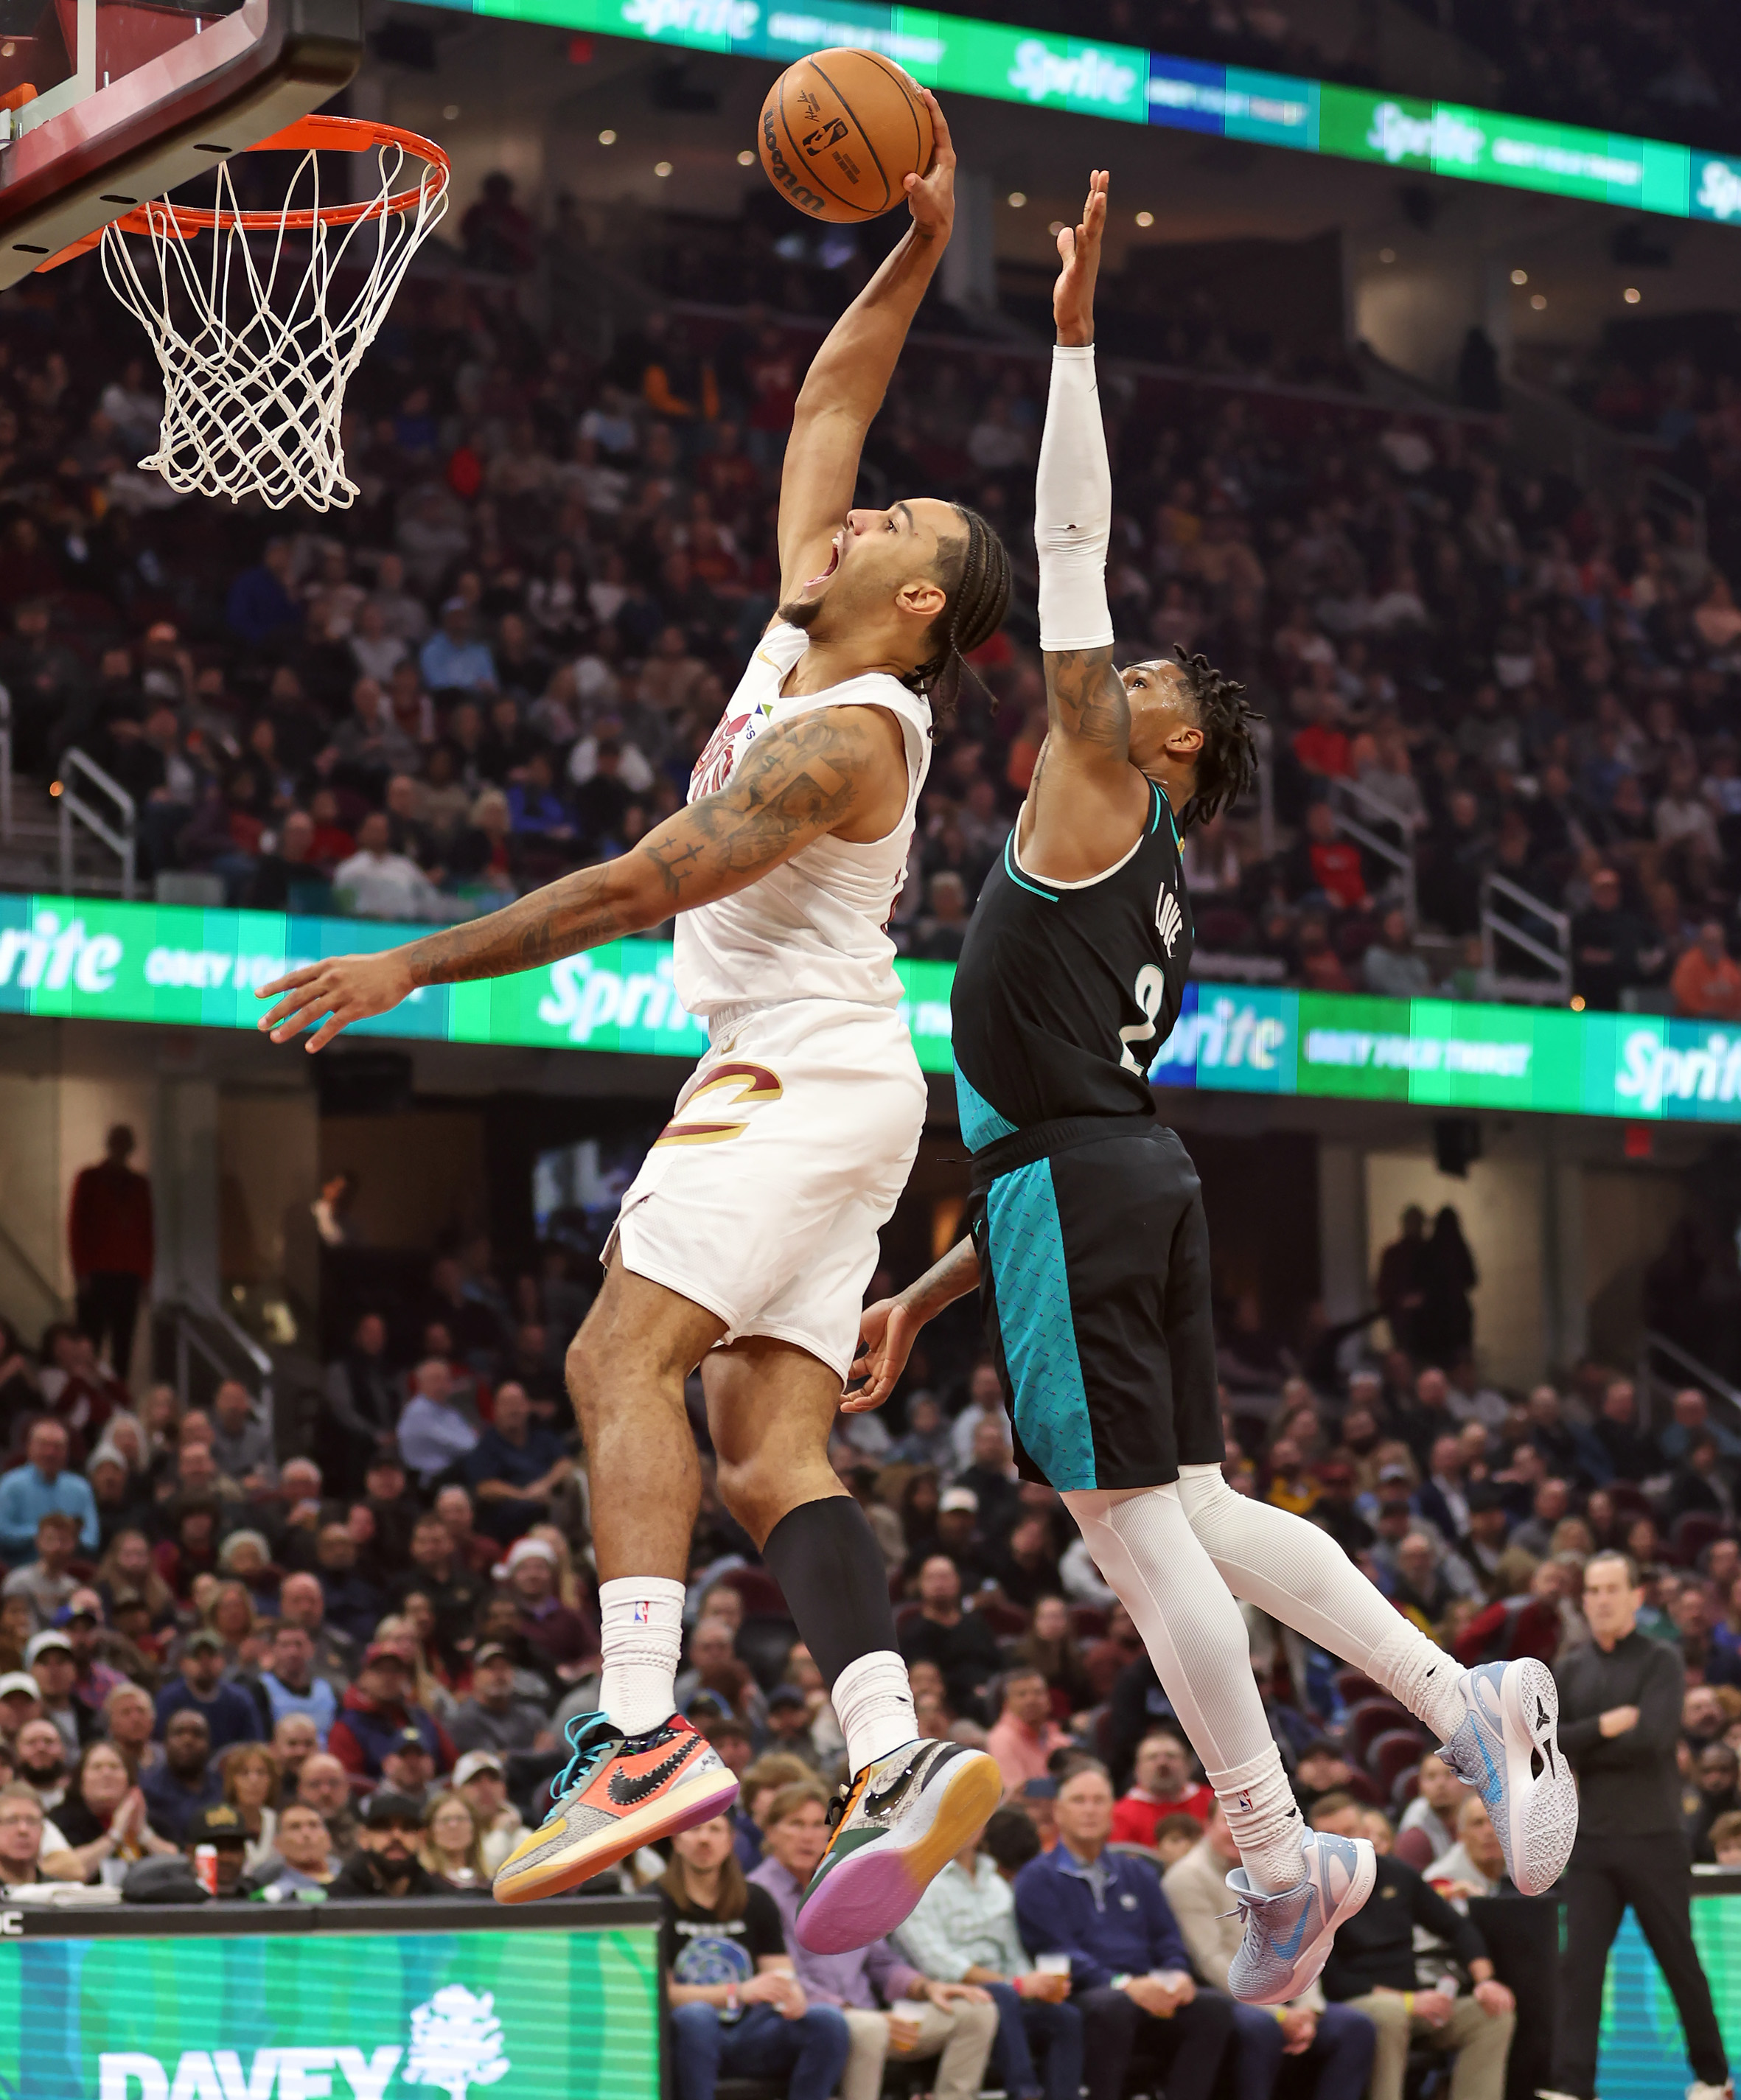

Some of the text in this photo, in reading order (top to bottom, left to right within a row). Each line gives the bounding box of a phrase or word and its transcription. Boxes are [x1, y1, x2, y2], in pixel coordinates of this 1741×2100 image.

[1008, 39, 1136, 105] Sprite
[1366, 102, 1486, 164] Sprite
[99, 2045, 405, 2100] DAVEY
